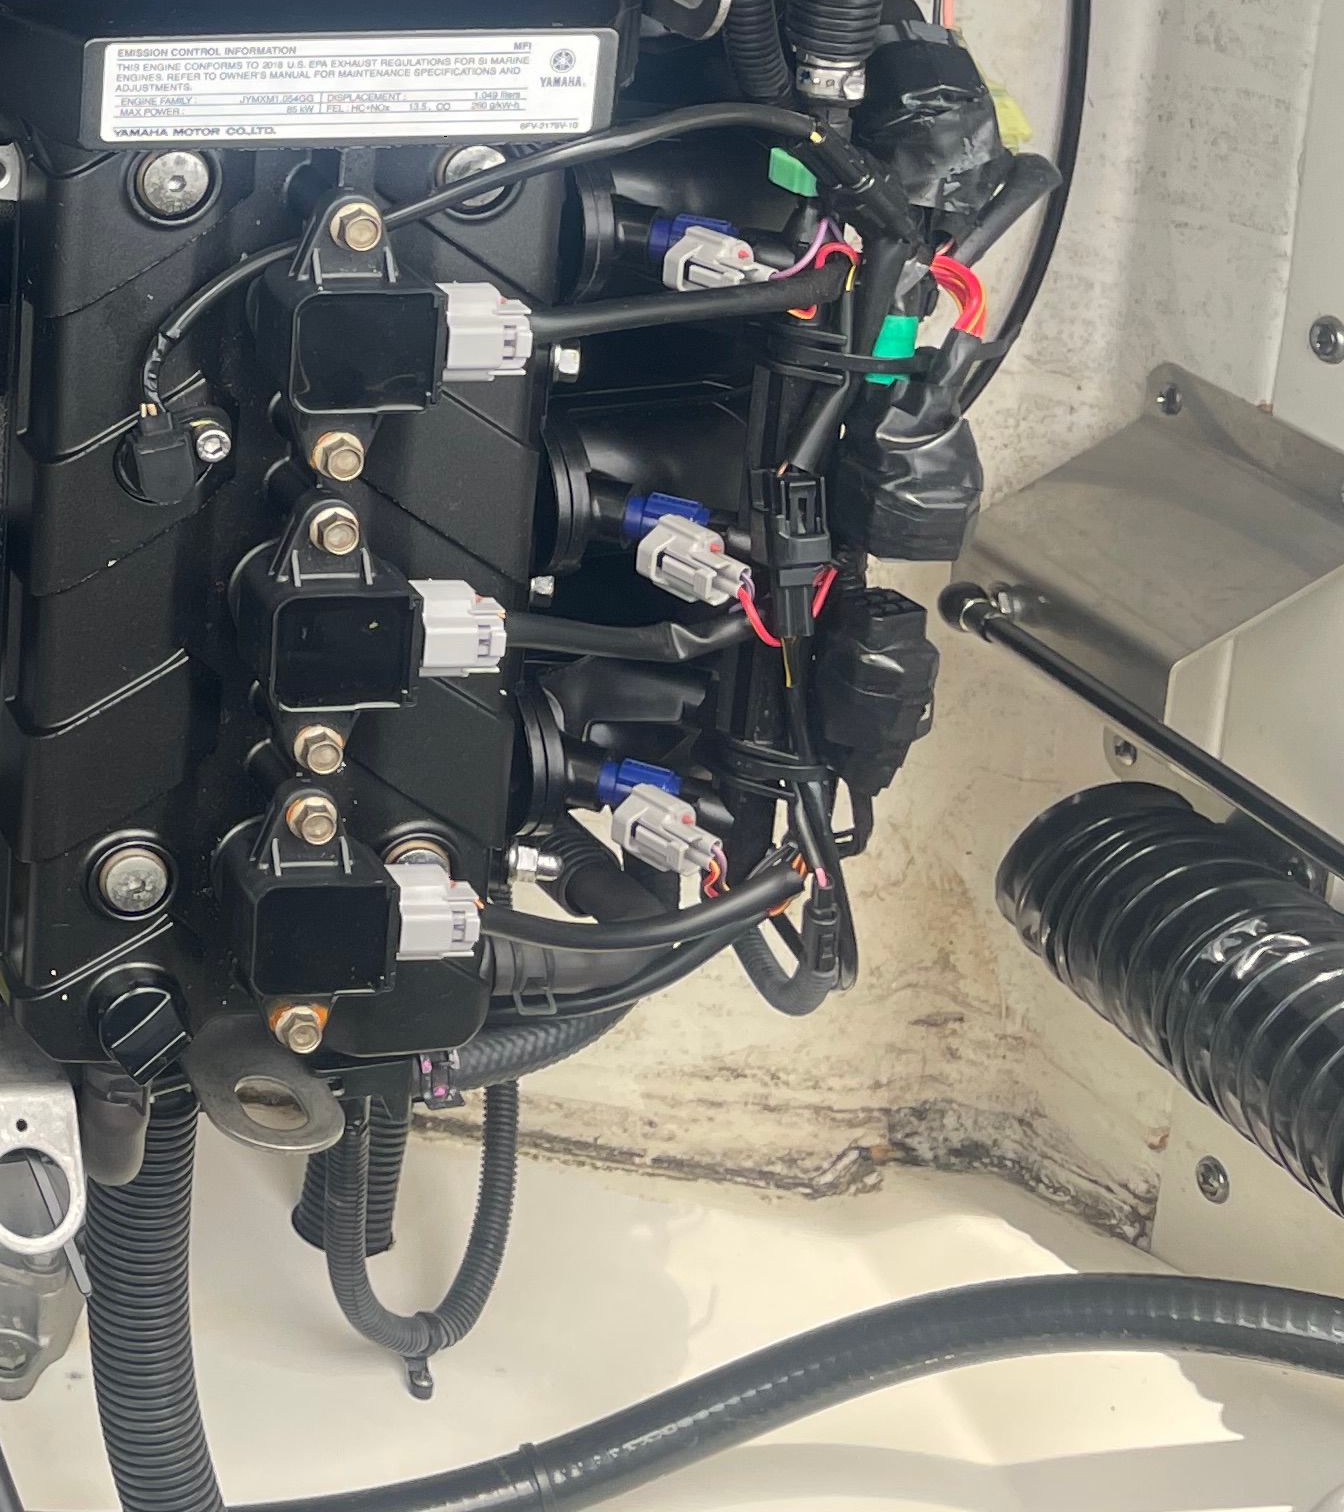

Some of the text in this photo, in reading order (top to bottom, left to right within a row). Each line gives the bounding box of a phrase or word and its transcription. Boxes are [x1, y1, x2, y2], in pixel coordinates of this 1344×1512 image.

[117, 47, 296, 58] EMISSION CONTROL INFORMATION
[117, 64, 140, 72] THIS
[185, 62, 243, 70] CONFORMS
[246, 61, 259, 69] TO
[309, 60, 327, 68] EPA
[331, 59, 378, 68] EXHAUST
[381, 58, 451, 67] REGULATIONS
[454, 58, 475, 66] FOR
[491, 57, 530, 65] MARINE
[167, 73, 200, 81] REFER
[204, 73, 217, 81] TO
[270, 71, 310, 79] MANUAL
[314, 70, 335, 78] FOR
[339, 69, 411, 78] MAINTENANCE
[414, 68, 496, 76] SPECIFICATIONS
[499, 67, 520, 75] AND
[540, 76, 582, 87] YAMAHA
[114, 128, 168, 136] YAMAHA
[173, 127, 220, 135] MOTOR
